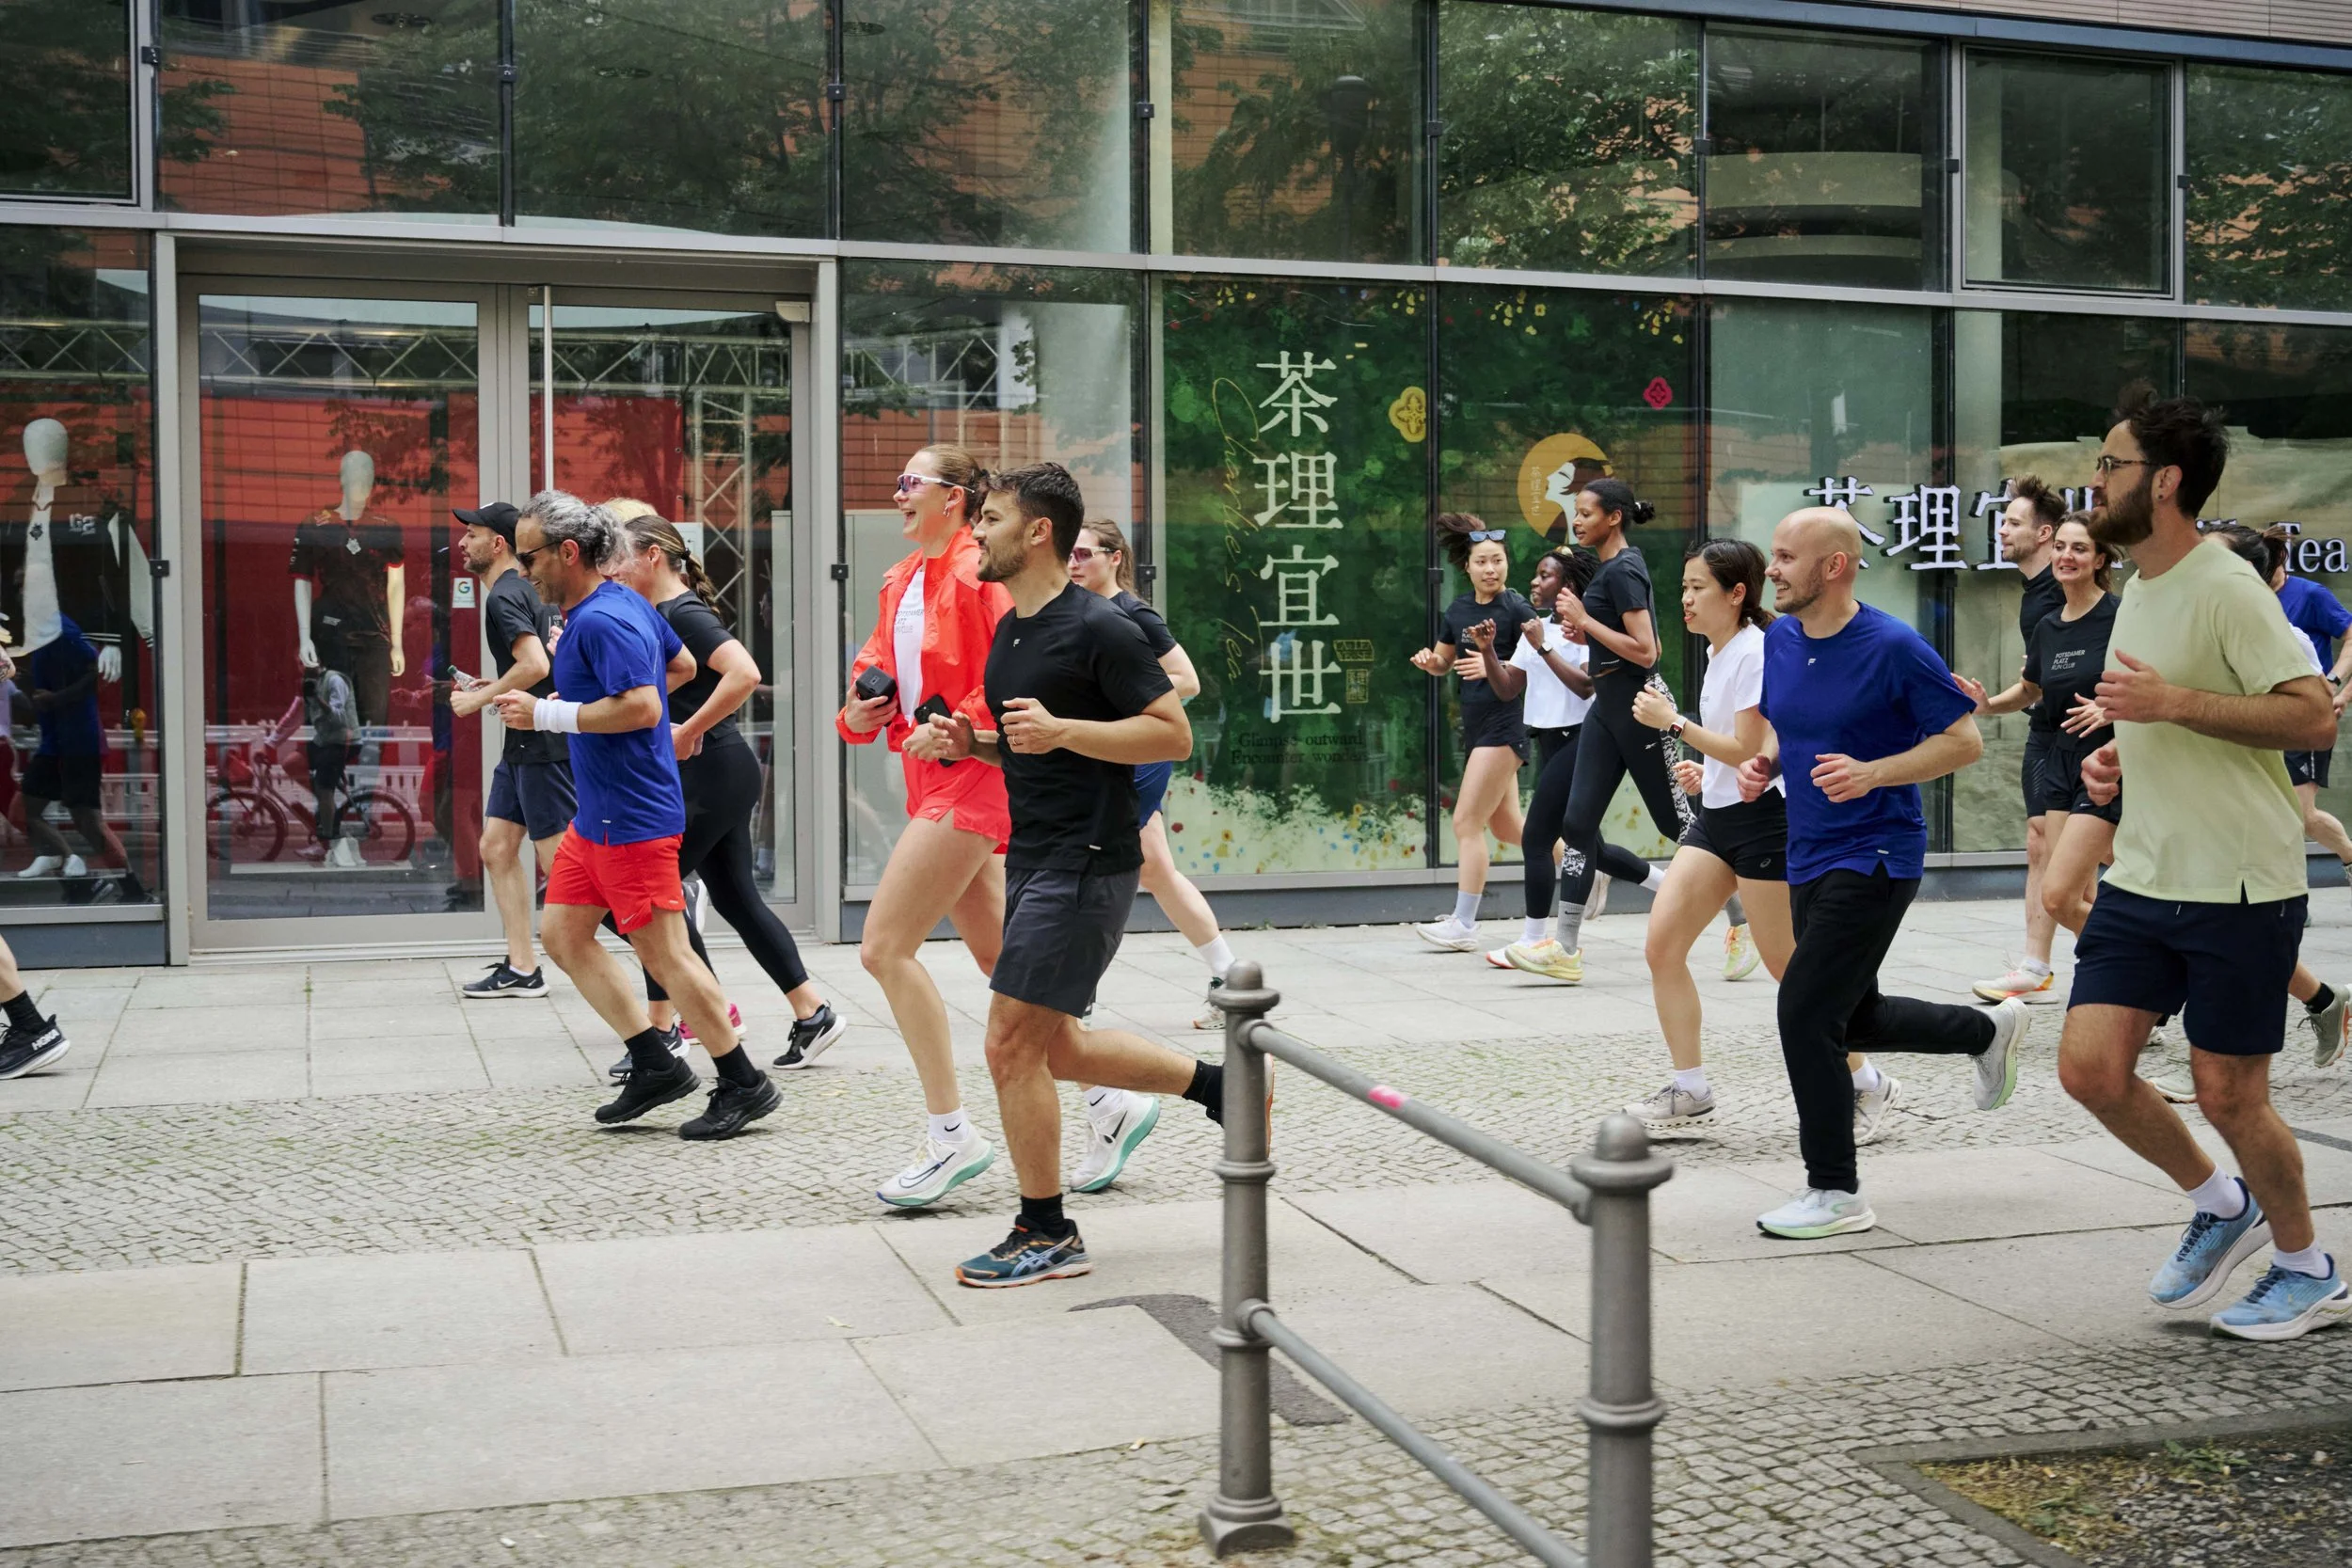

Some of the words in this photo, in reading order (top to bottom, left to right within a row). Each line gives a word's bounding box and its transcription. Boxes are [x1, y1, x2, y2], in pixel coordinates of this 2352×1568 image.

[1253, 351, 1343, 723] 茶理宜世
[2275, 522, 2349, 573] Tea
[2056, 650, 2086, 658] POTSDAMER
[1305, 730, 1363, 746] outward
[31, 1028, 60, 1051] HOKA
